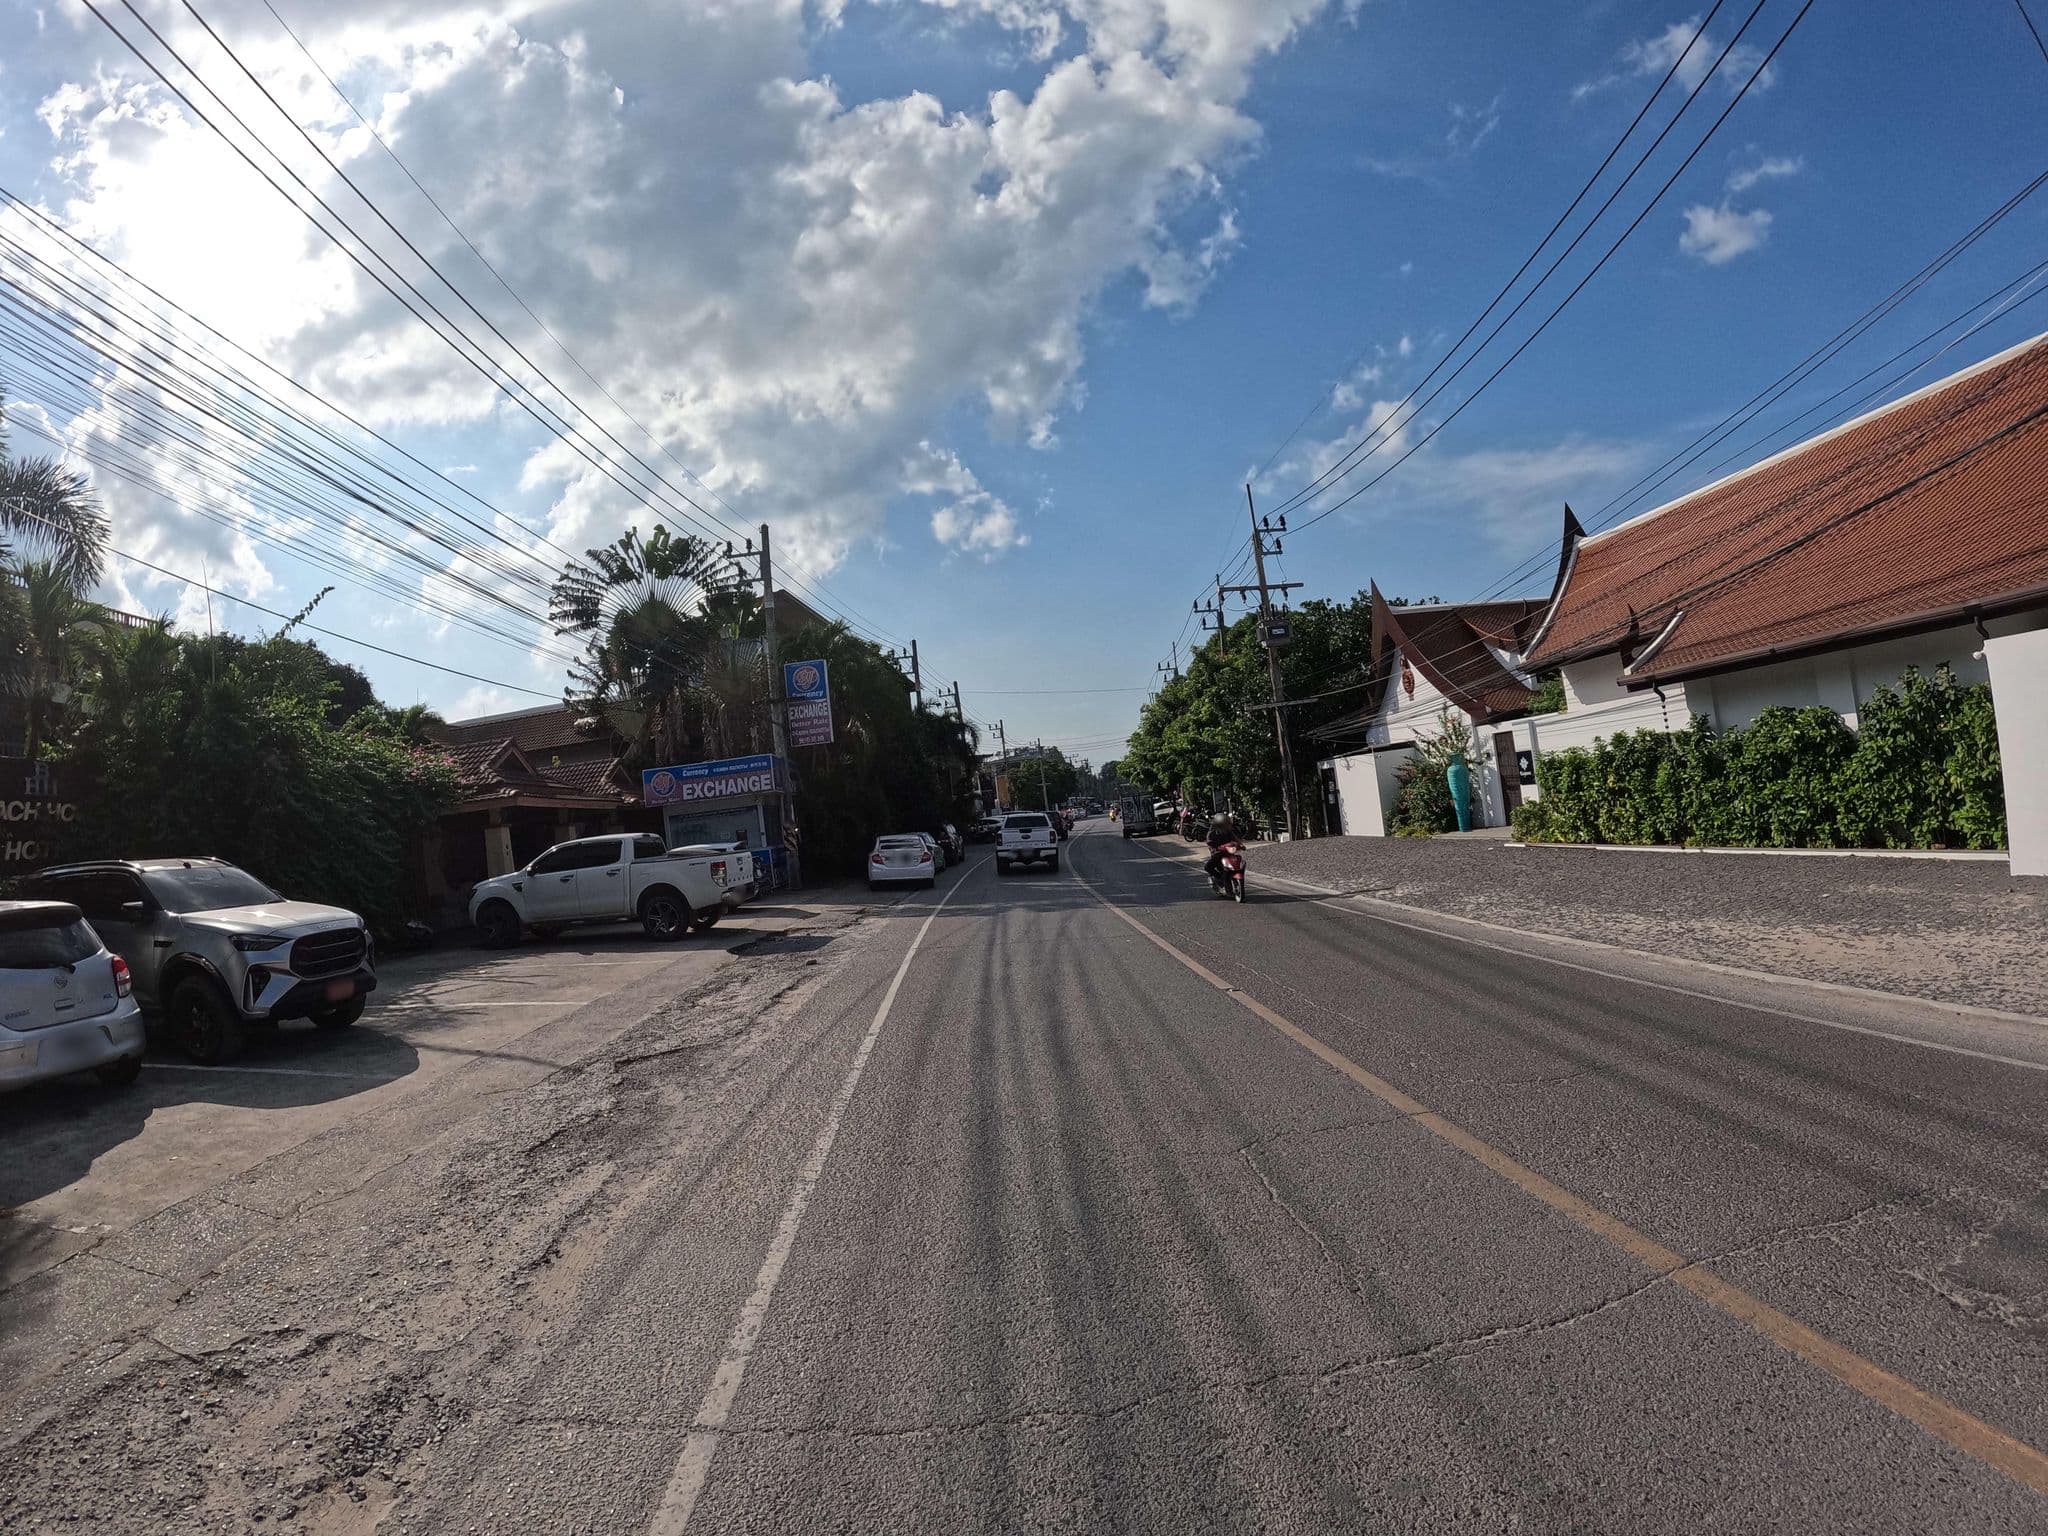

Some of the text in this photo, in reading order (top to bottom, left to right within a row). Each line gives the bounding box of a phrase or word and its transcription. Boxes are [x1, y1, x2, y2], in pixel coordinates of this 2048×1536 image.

[789, 702, 828, 719] EXCHANGE
[682, 768, 709, 777] Currency
[682, 773, 771, 800] EXCHANGE
